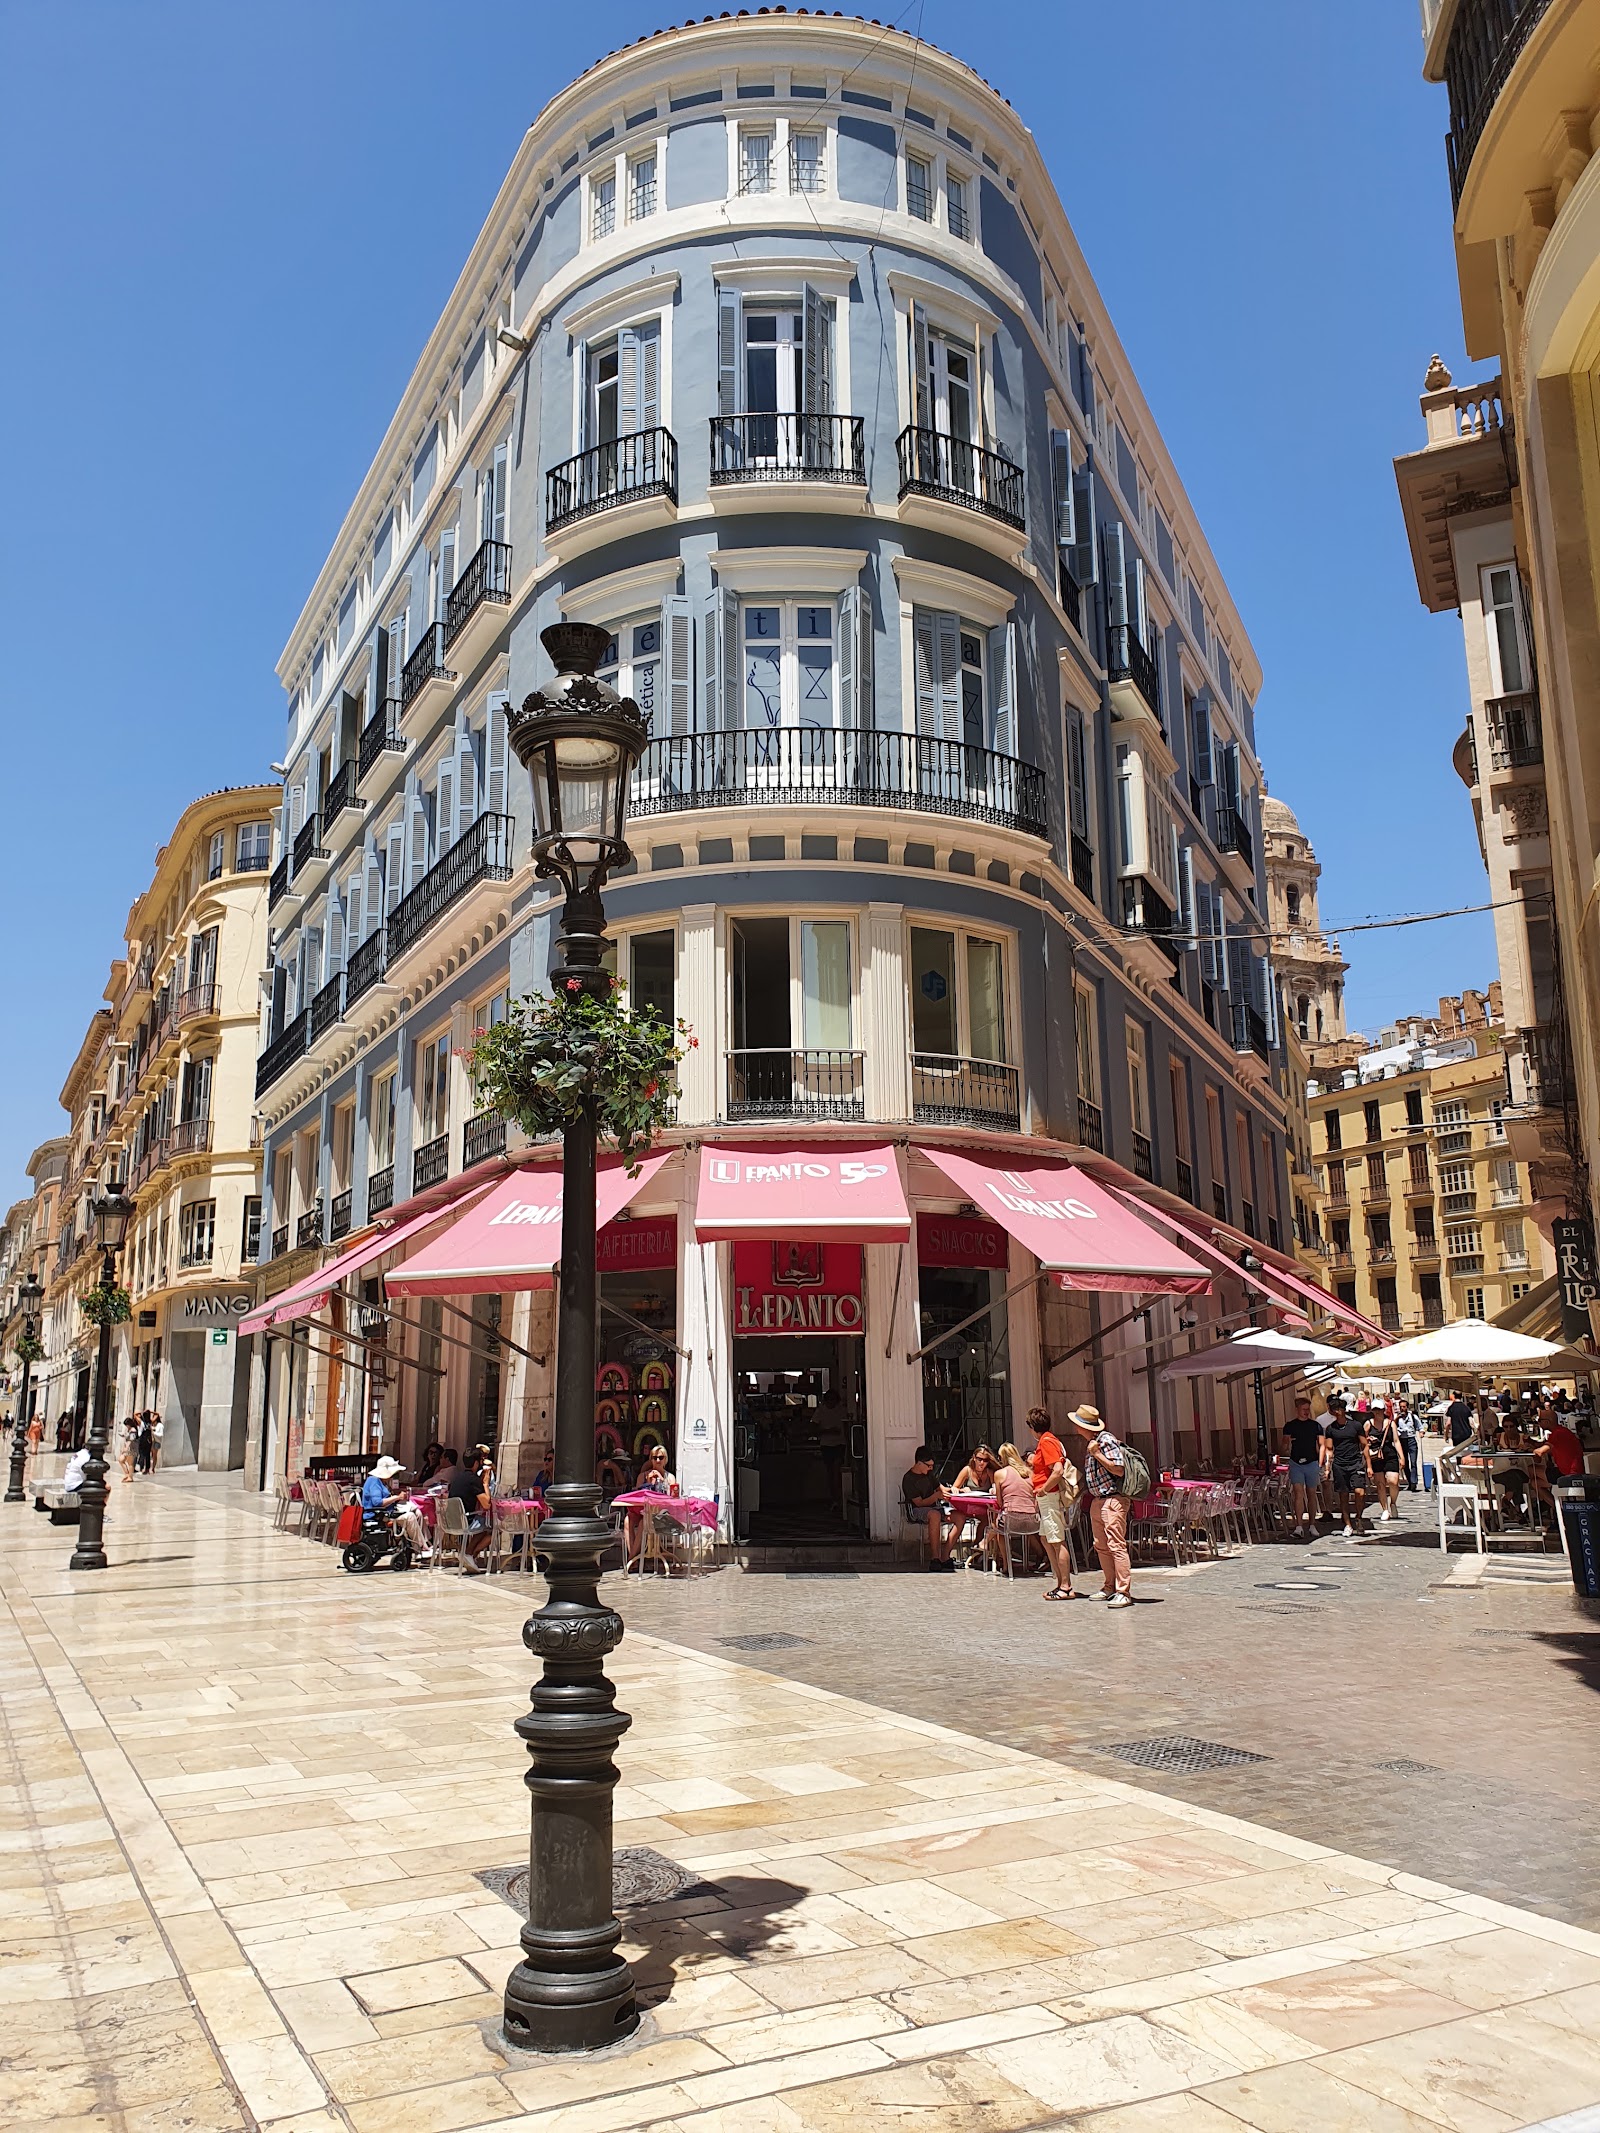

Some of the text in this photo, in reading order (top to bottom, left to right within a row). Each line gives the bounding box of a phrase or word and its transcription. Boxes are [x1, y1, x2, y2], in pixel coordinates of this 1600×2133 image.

[984, 1182, 1098, 1220] LEPANTO
[929, 1229, 997, 1256] SNACKS
[1562, 1227, 1580, 1238] EL
[736, 1286, 863, 1328] LEPANTO
[1580, 1518, 1596, 1586] GRACIAS
